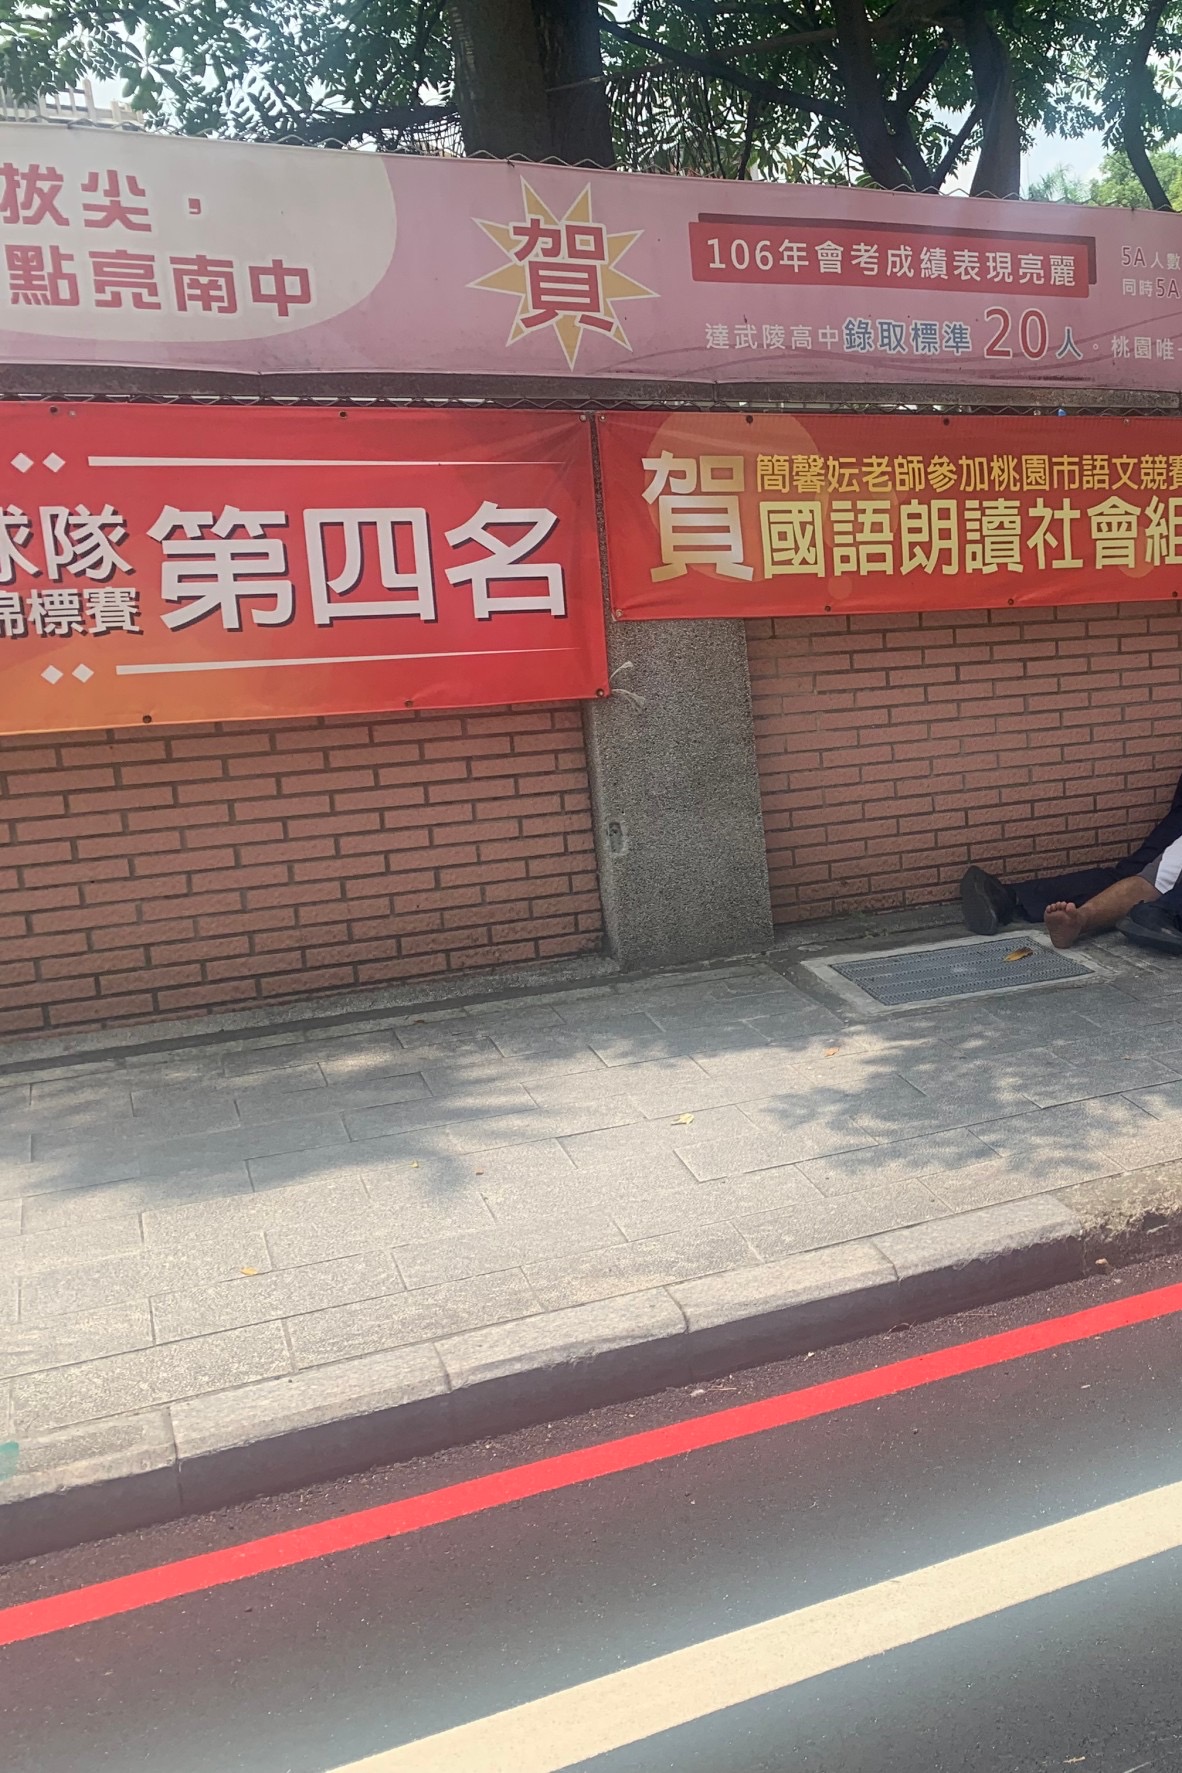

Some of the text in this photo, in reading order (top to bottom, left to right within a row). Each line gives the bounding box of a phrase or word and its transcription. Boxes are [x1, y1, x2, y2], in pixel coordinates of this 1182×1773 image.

[5, 244, 313, 317] 點亮南中
[510, 218, 617, 333] 賀
[706, 238, 1076, 287] 106年會考成績表現亮麗
[146, 501, 566, 630] 第四名
[642, 450, 754, 583] 賀
